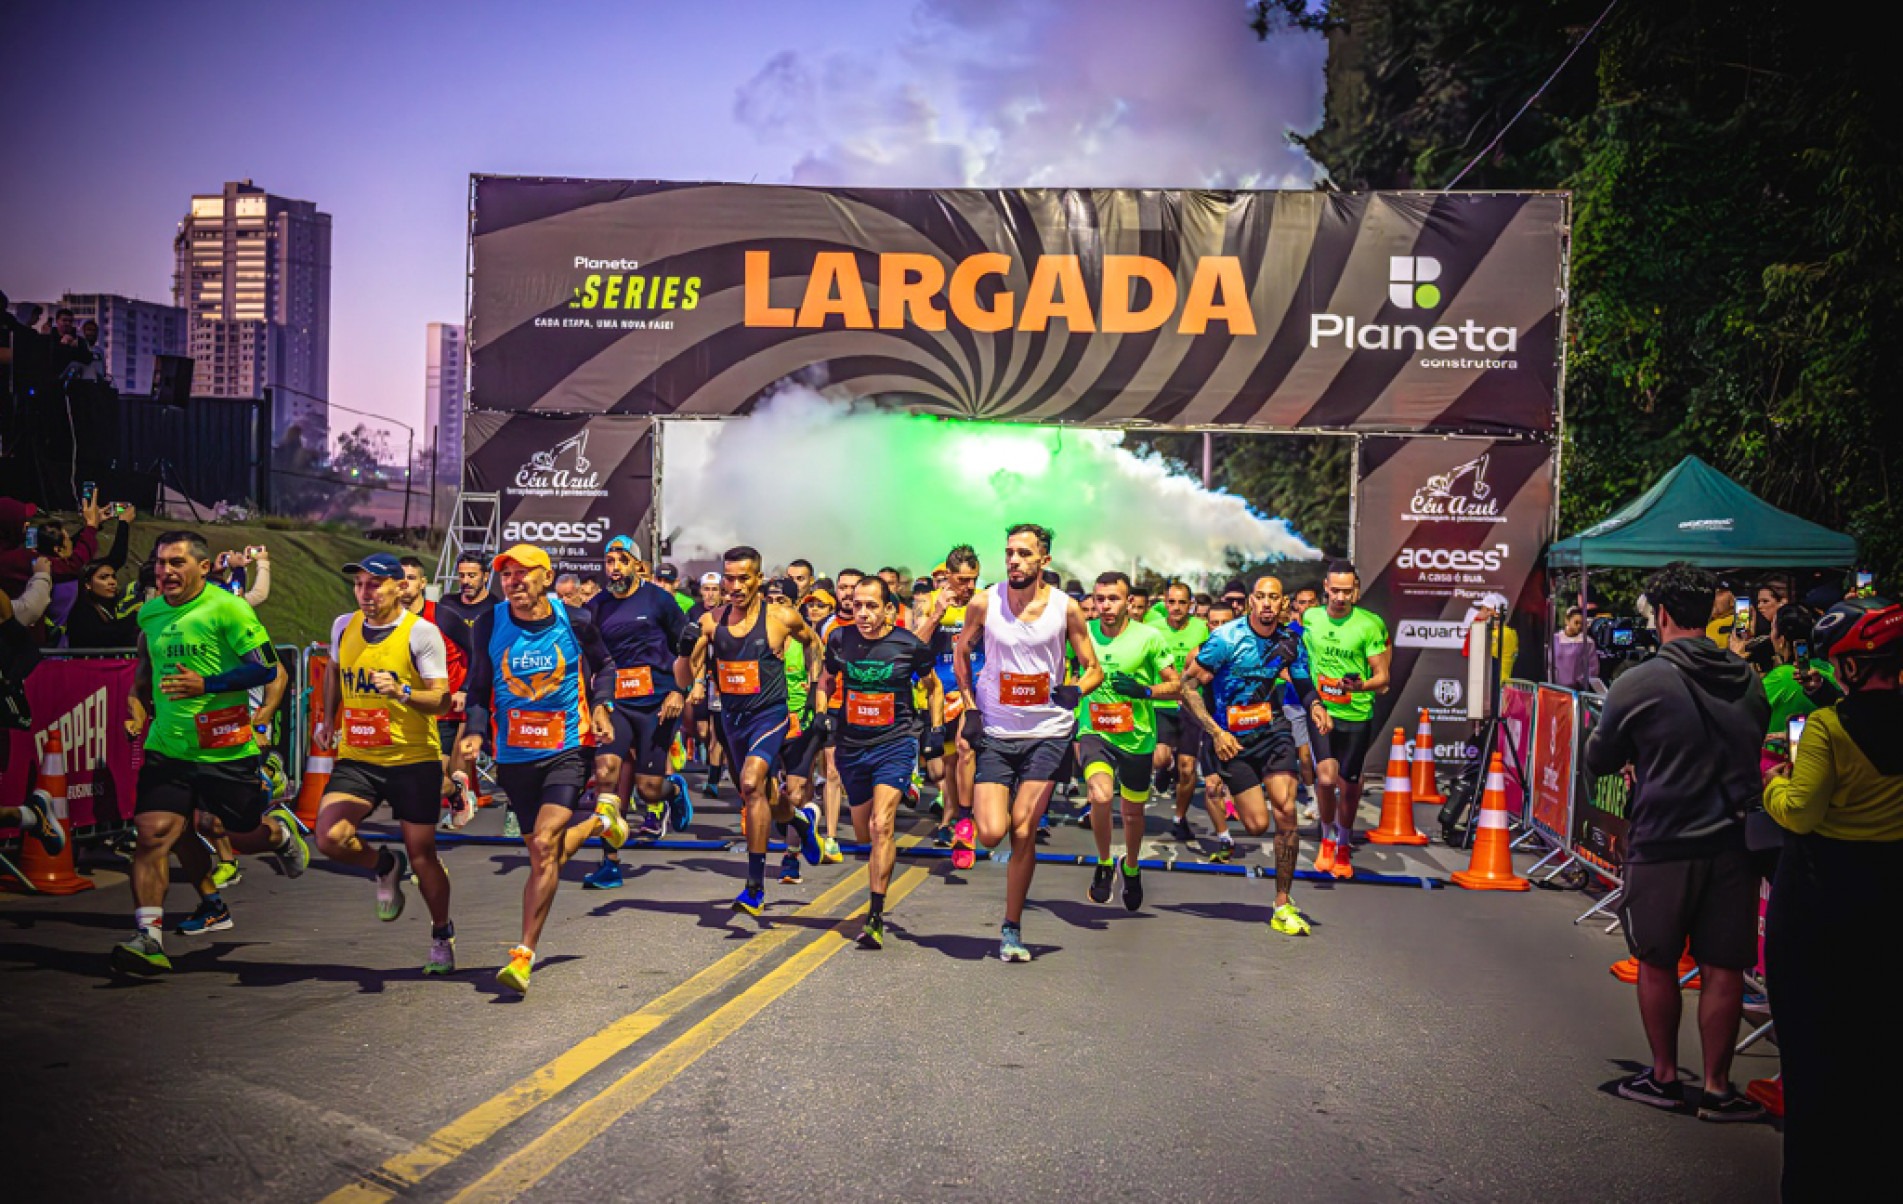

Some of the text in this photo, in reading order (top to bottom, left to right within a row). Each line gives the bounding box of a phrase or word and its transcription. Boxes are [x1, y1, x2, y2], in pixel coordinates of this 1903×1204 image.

[574, 256, 638, 270] Planeta
[582, 275, 701, 310] SERIES
[745, 250, 1256, 335] LARGADA
[535, 317, 560, 328] CADA
[563, 318, 594, 329] ETAPA,
[597, 319, 619, 328] UMA
[621, 319, 646, 329] NOVA
[1310, 313, 1517, 352] Planeta
[1420, 358, 1518, 370] construtora
[515, 470, 600, 489] Céu Azul
[1410, 495, 1499, 516] Céu Azul
[503, 521, 603, 543] access
[559, 561, 602, 571] Planeta
[1397, 548, 1501, 571] access
[1418, 571, 1427, 581] A
[1428, 573, 1453, 583] casa
